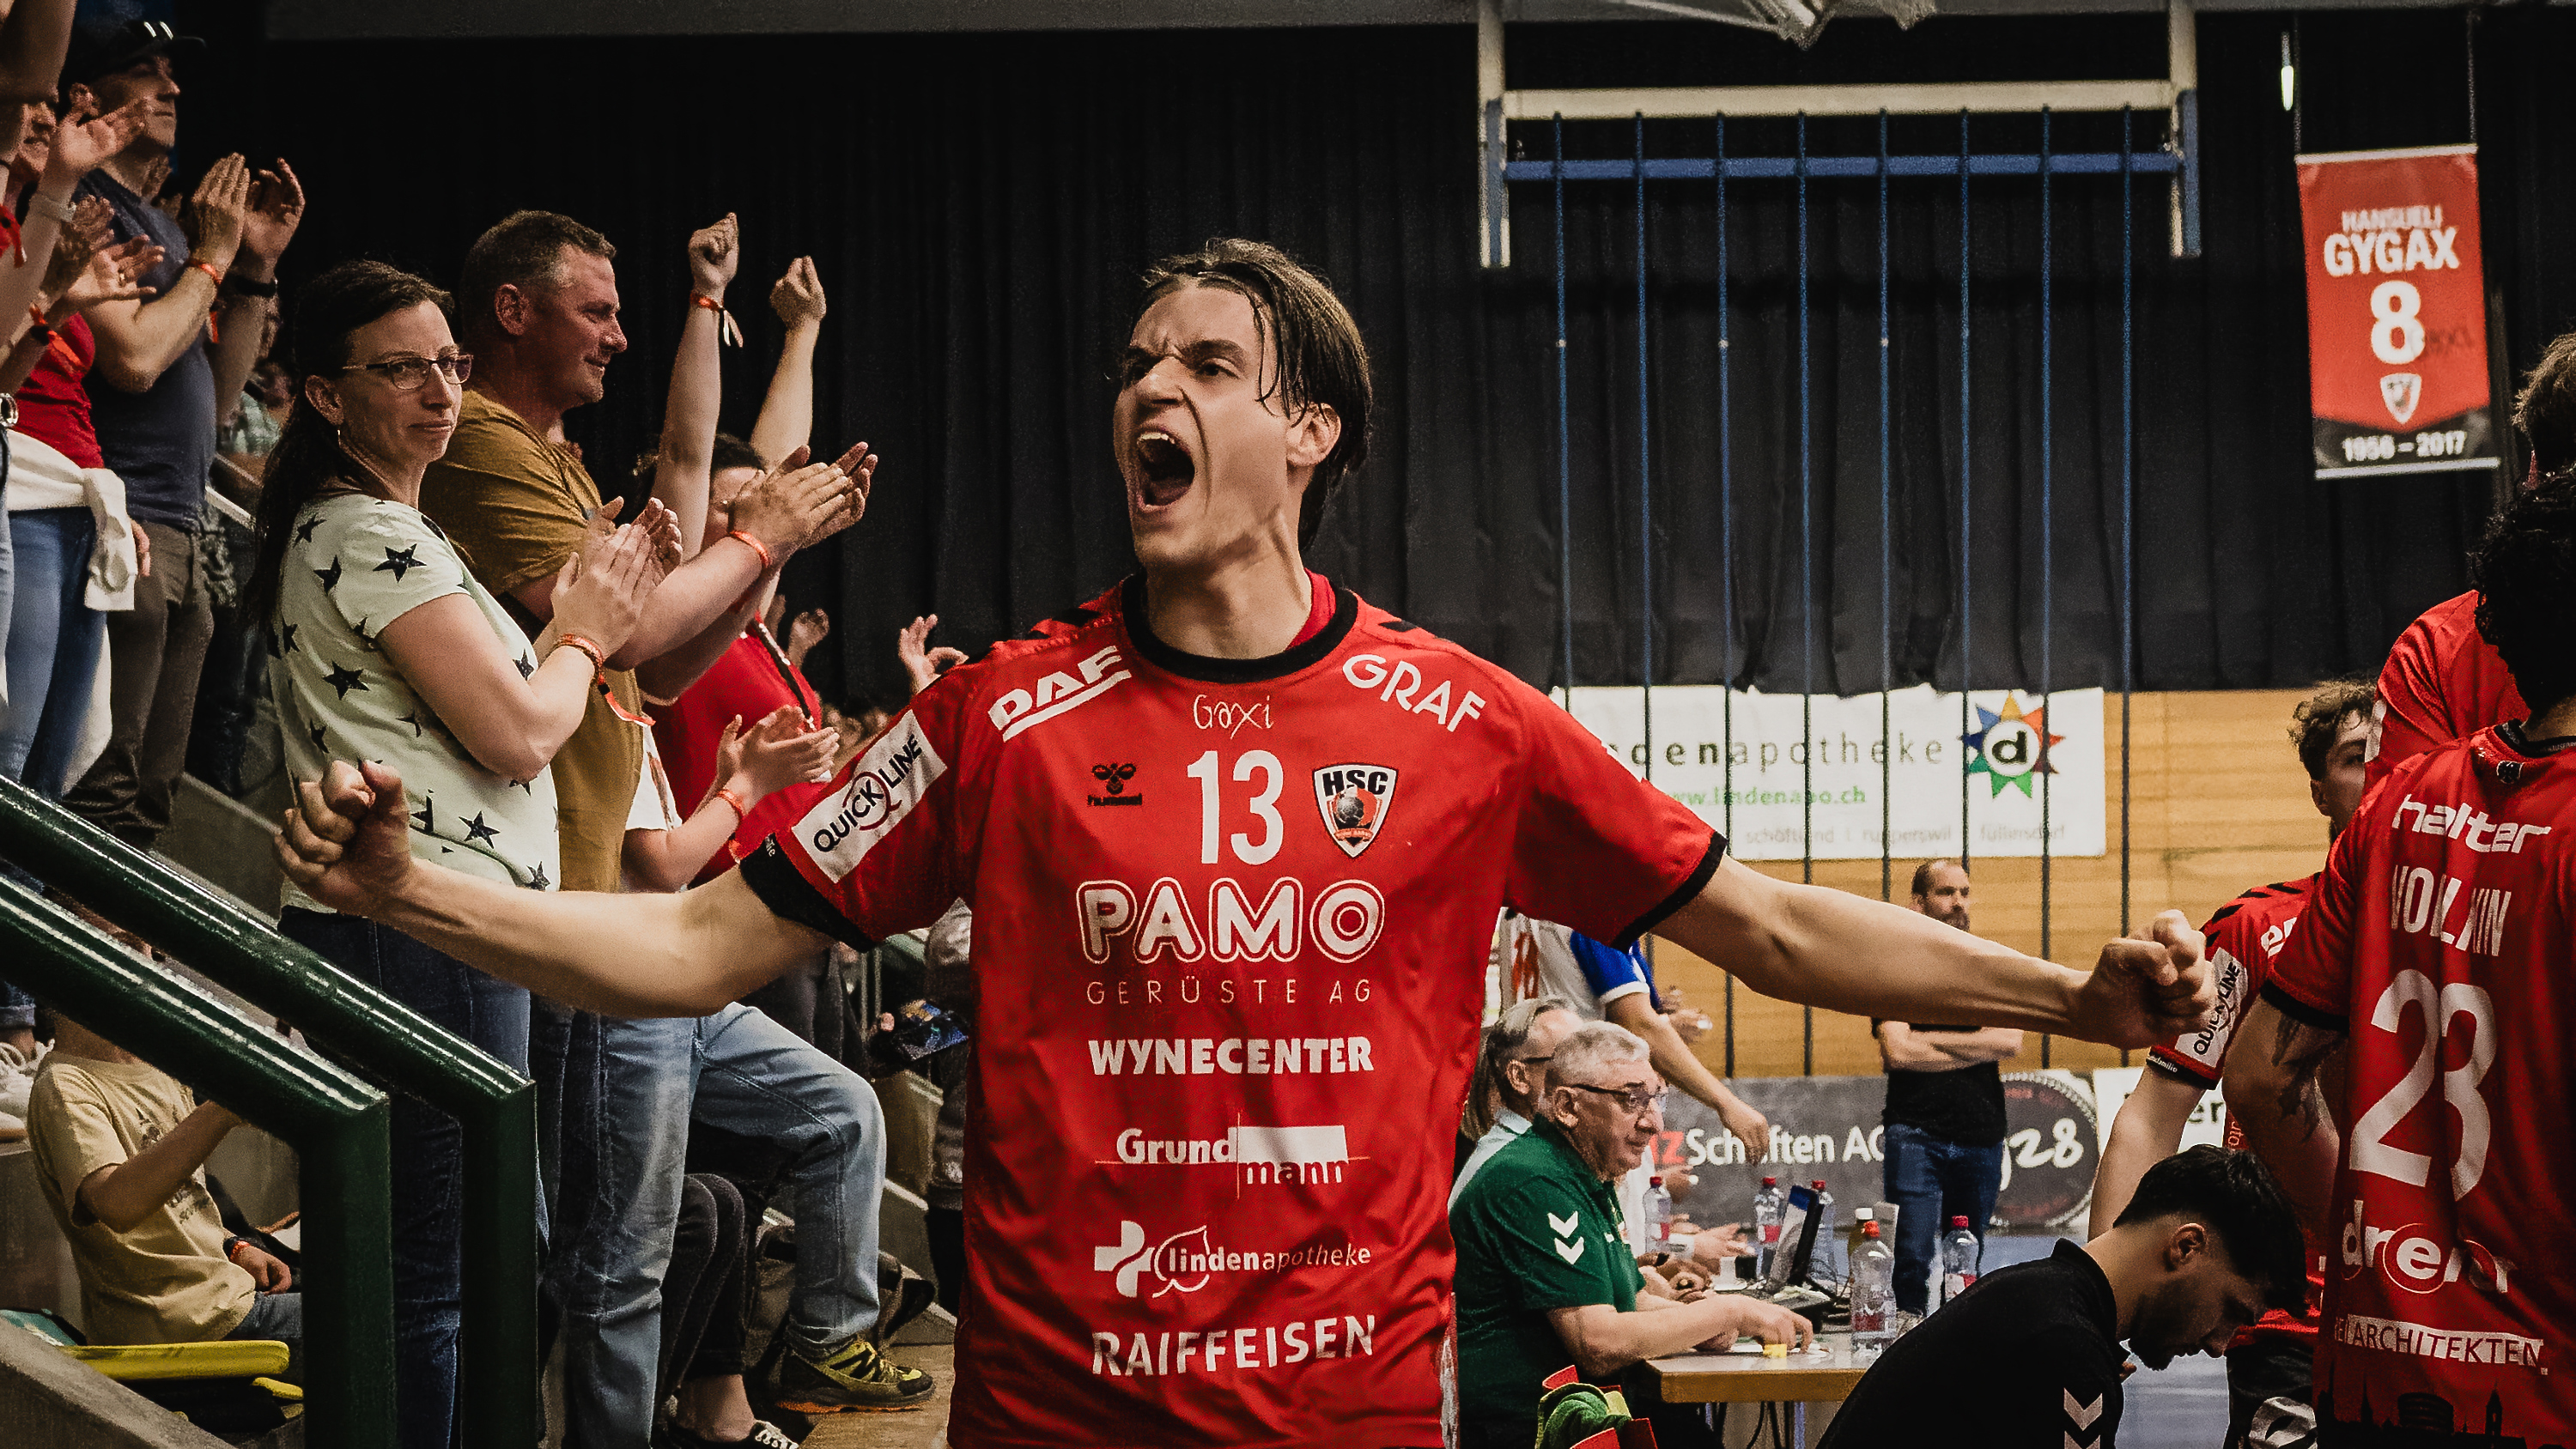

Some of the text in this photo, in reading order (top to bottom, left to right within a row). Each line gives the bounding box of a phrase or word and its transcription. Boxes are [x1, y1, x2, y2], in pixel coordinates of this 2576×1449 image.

[2324, 225, 2461, 276] GYGAX
[2370, 280, 2426, 365] 8
[2415, 430, 2467, 458] 2017
[987, 646, 1121, 731] DAF
[1341, 653, 1486, 733] GRAF
[1193, 694, 1274, 739] Gaxi
[1188, 749, 1284, 865] 13
[1322, 770, 1388, 797] HSC
[2391, 793, 2551, 854] halter
[1075, 876, 1385, 964] PAMO
[1086, 975, 1370, 1004] GERÜSTE AG
[1087, 1036, 1374, 1076] WYNECENTER
[2349, 968, 2497, 1202] 23
[1117, 1127, 1237, 1164] Grund
[1686, 1125, 1835, 1166] Schften
[1245, 1158, 1346, 1185] mann
[1170, 1244, 1371, 1273] lindenapotheke
[1091, 1314, 1375, 1376] RAIFFEISEN
